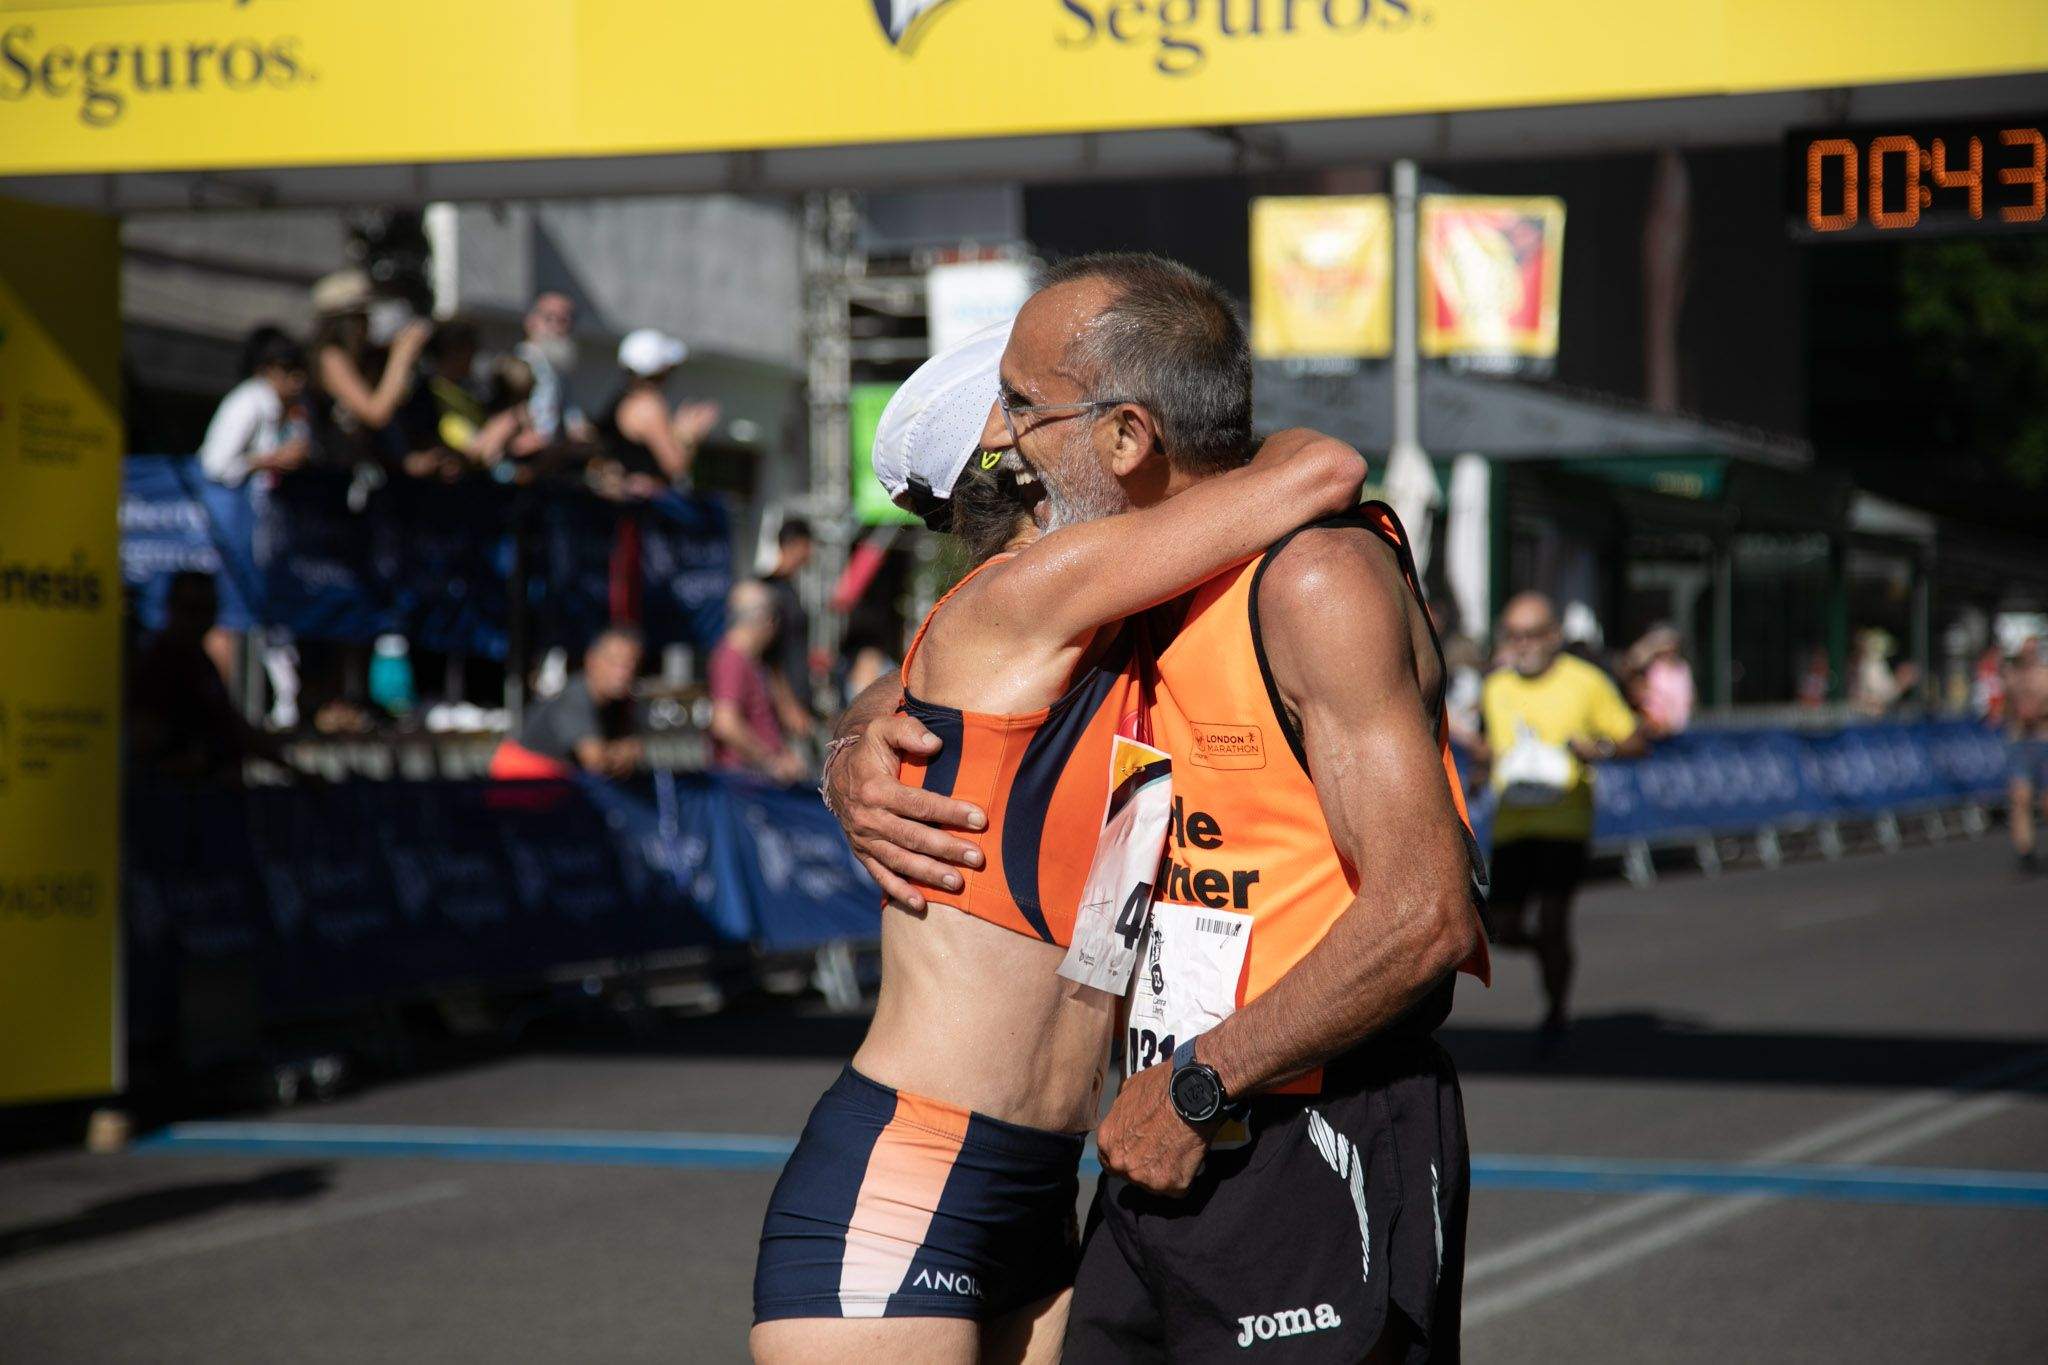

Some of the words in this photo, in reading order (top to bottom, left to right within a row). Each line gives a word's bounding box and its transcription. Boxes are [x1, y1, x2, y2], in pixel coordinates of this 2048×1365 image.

[1206, 735, 1245, 744] LONDON
[1207, 745, 1259, 753] MARATHON
[1237, 1303, 1341, 1348] Joma
